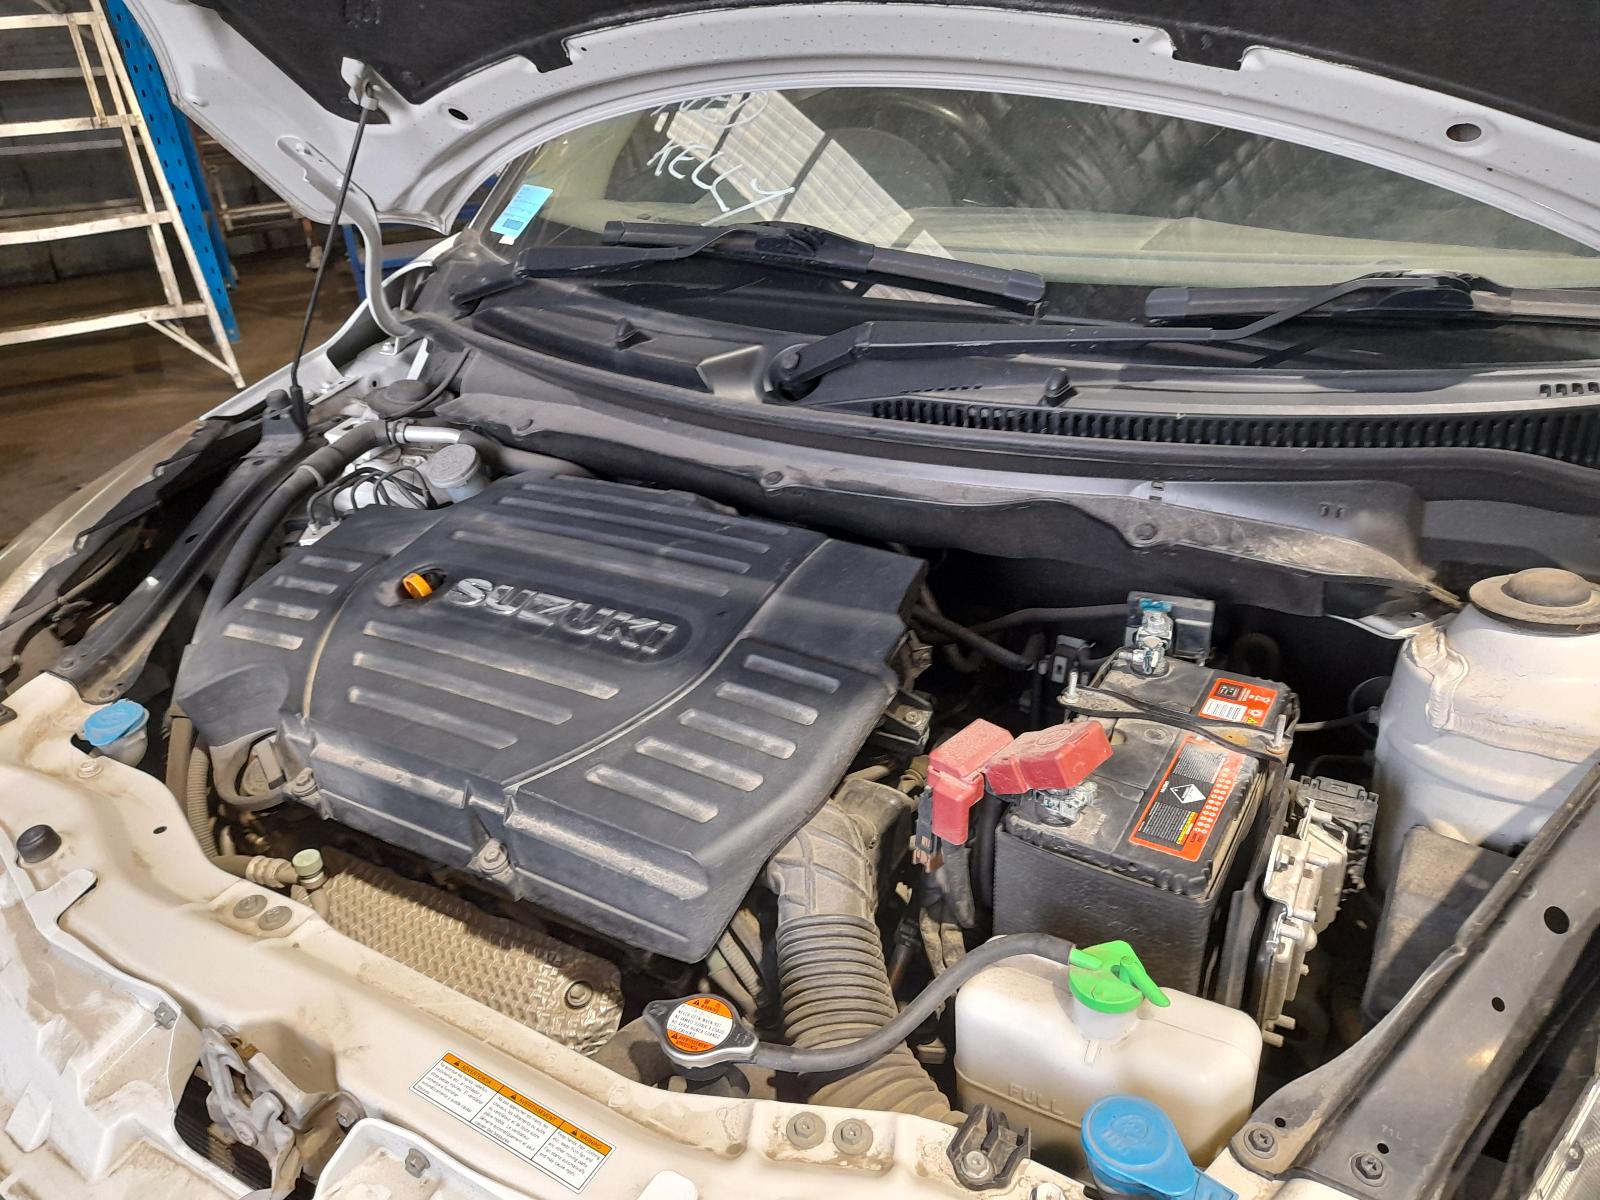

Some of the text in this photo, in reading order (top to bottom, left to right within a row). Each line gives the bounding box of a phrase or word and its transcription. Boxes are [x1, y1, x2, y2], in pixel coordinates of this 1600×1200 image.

[446, 578, 679, 655] SUZUKI
[1008, 1082, 1064, 1116] FULL
[577, 1132, 603, 1149] WARNING
